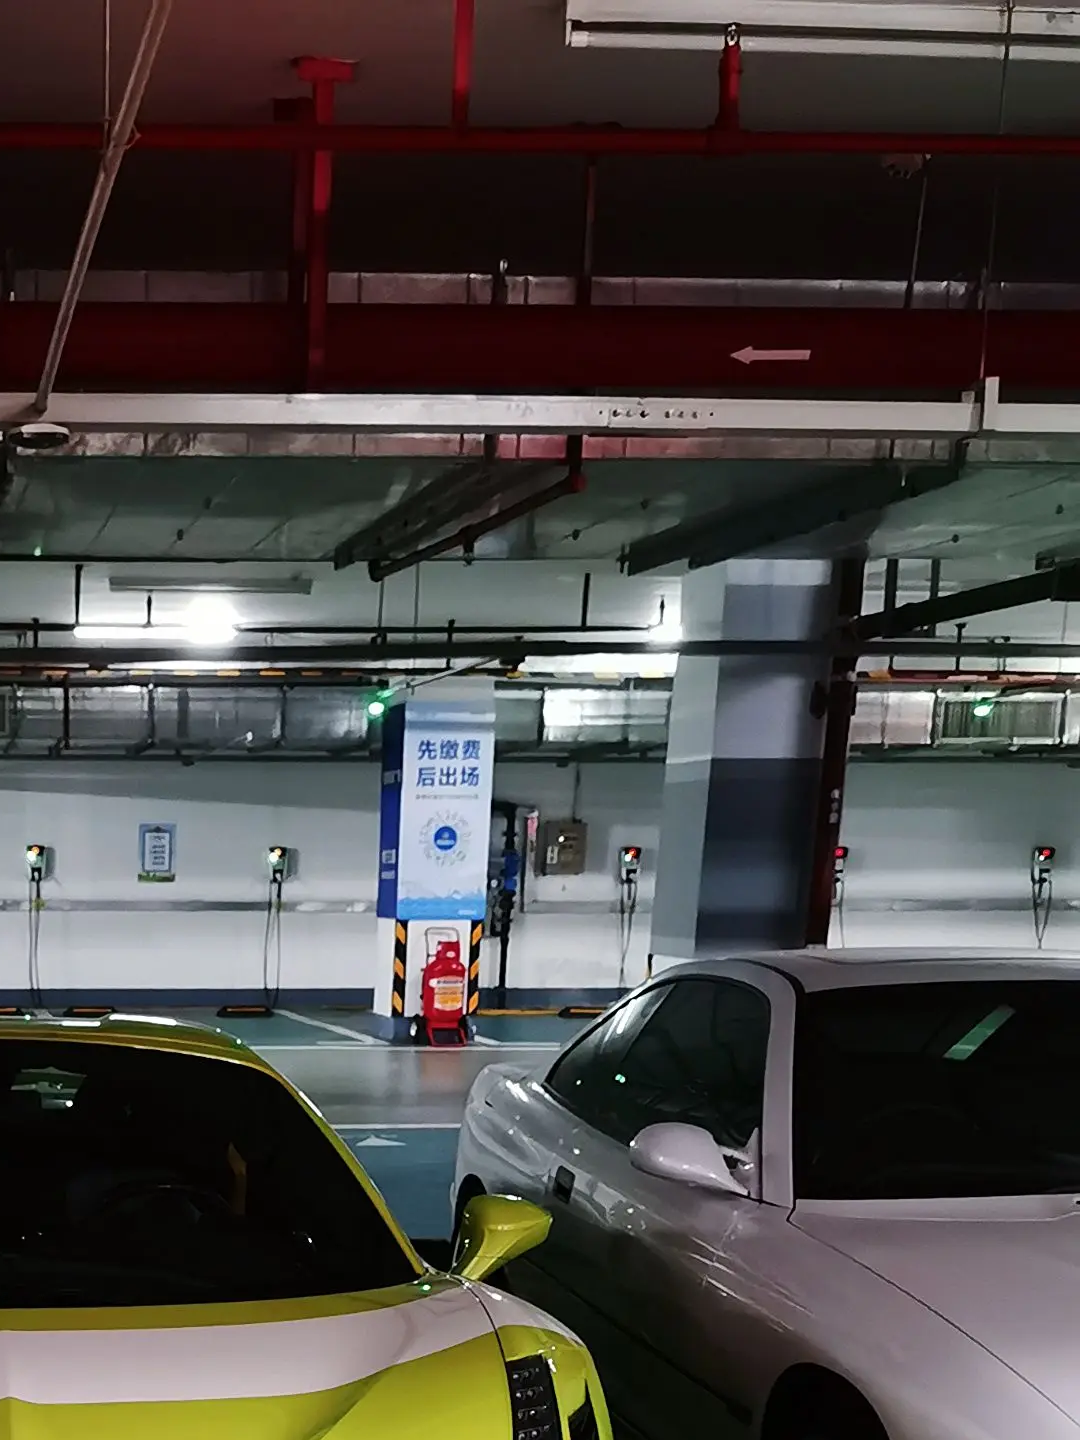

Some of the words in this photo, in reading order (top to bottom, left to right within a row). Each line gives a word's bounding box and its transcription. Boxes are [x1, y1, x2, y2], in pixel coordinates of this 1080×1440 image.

[417, 739, 481, 760] 先缴费
[416, 766, 479, 787] 后出场
